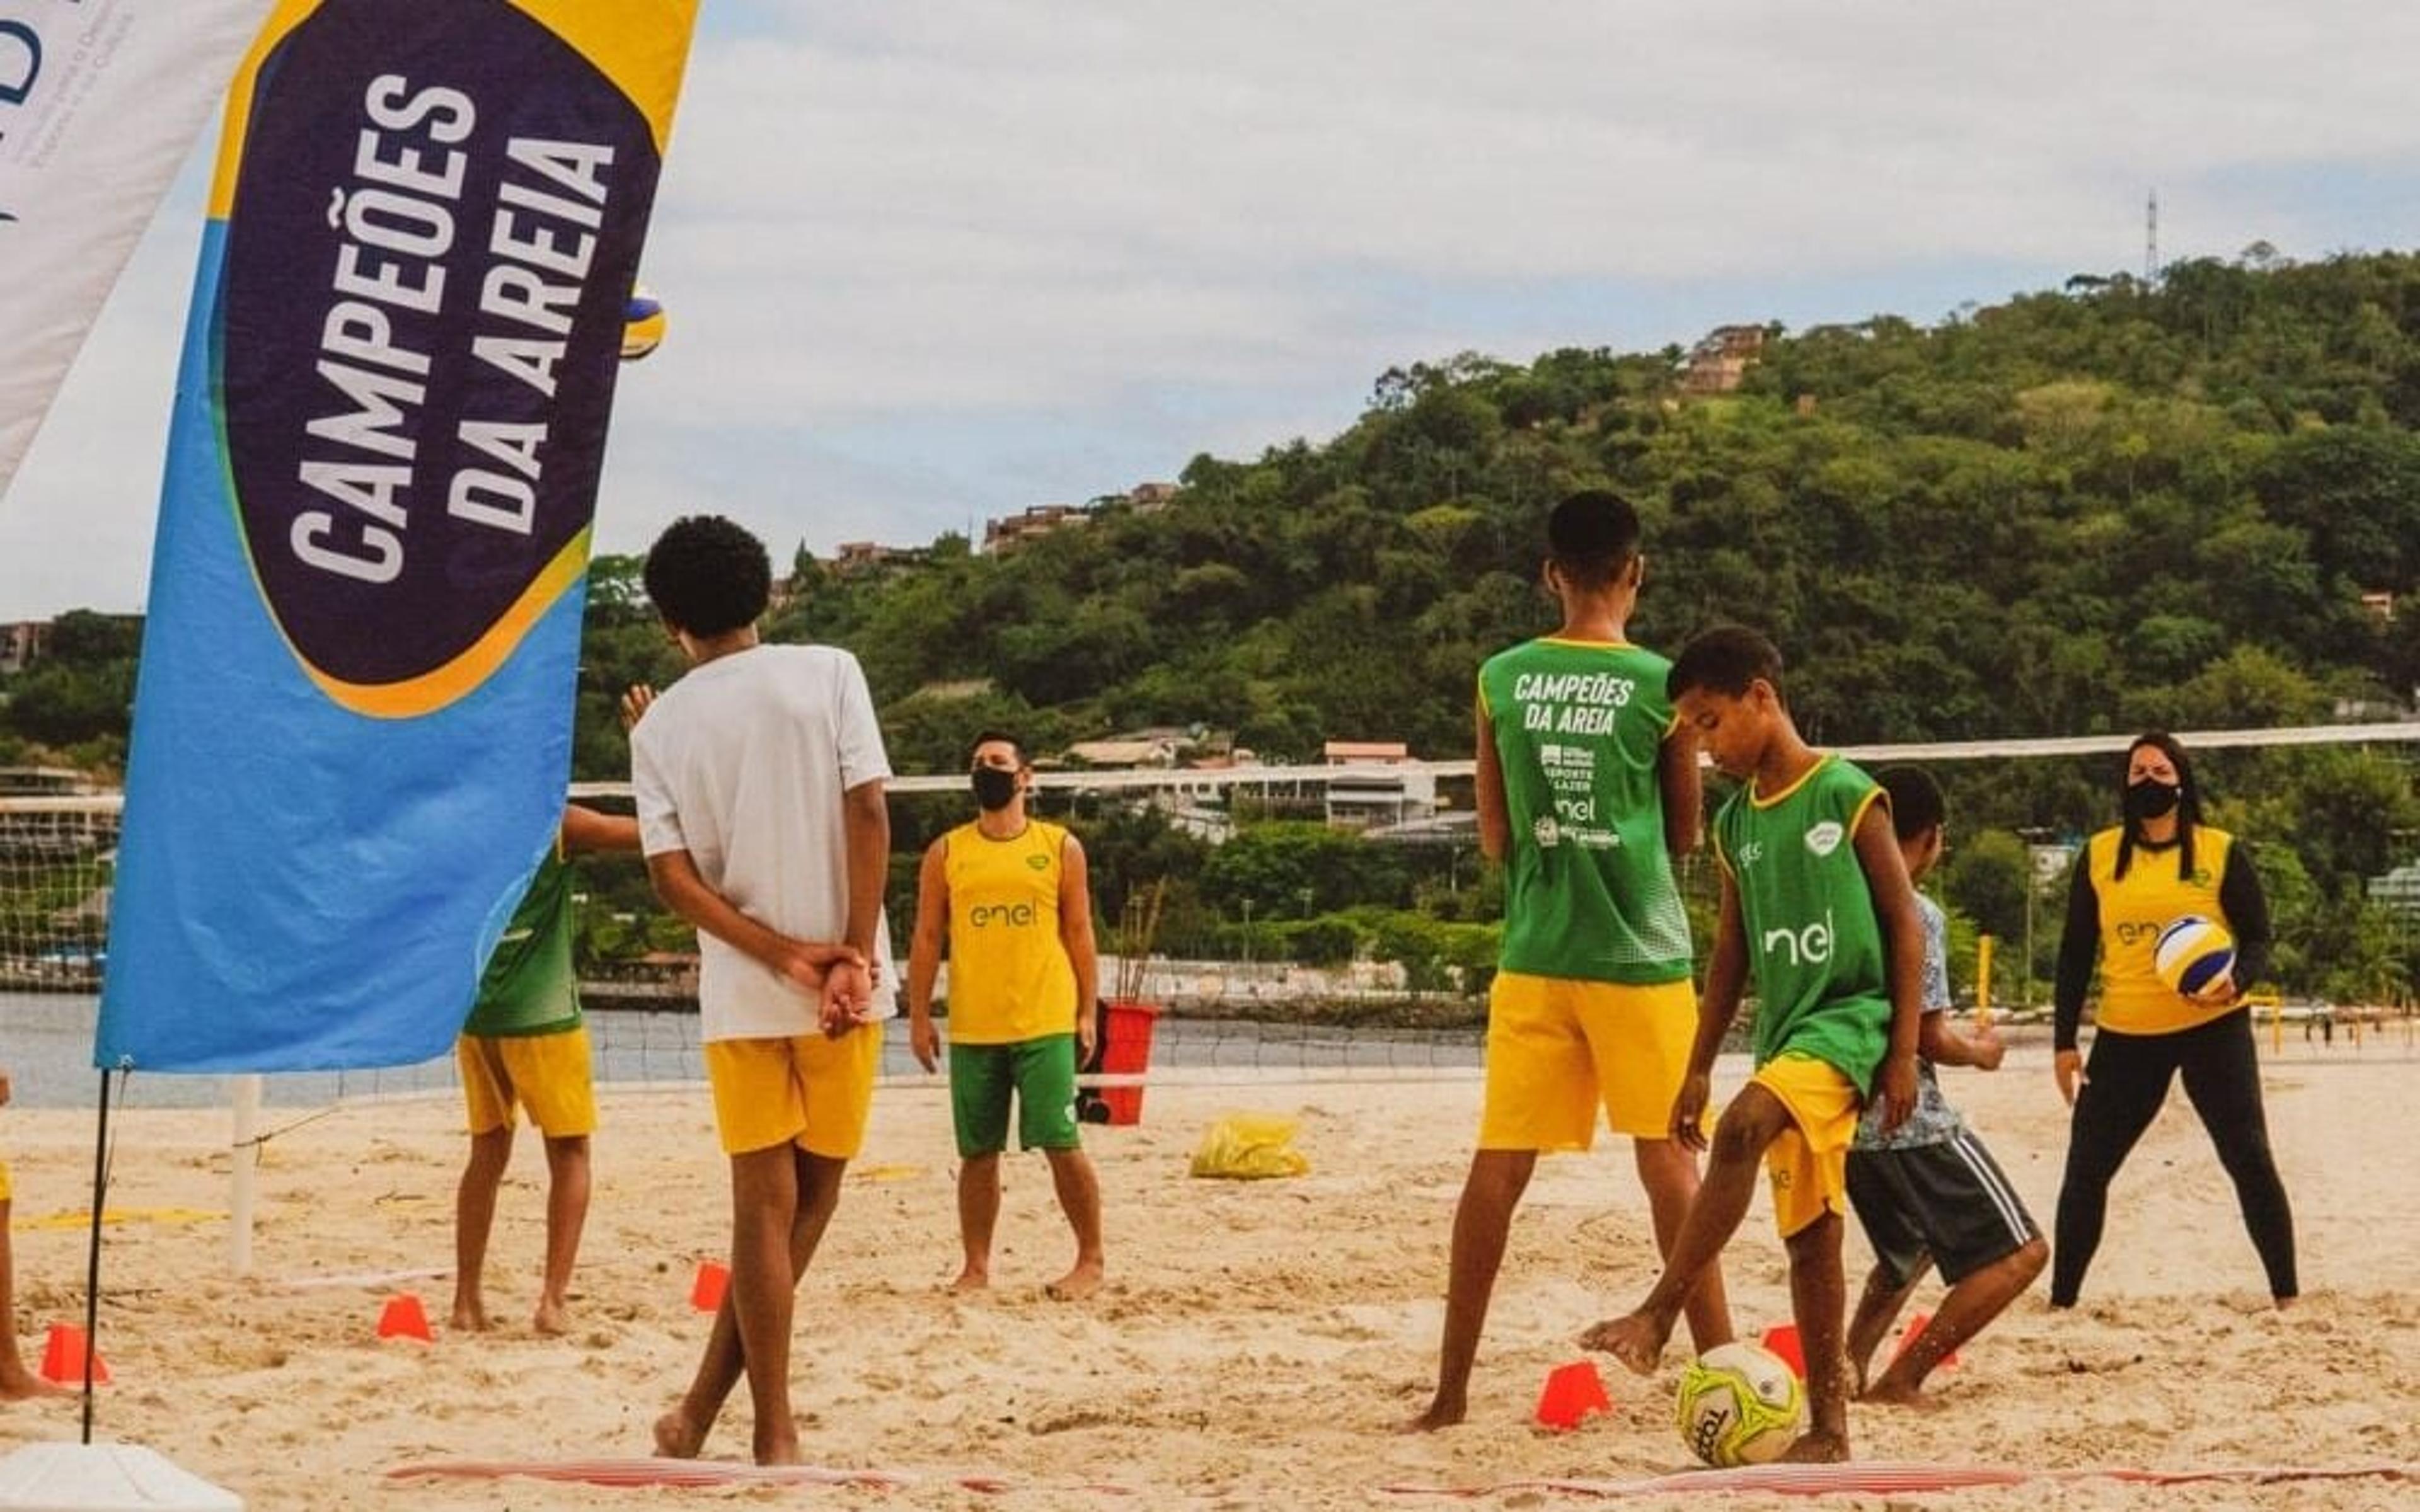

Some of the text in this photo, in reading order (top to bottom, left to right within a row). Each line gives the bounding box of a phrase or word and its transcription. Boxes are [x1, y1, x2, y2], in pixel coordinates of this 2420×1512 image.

[289, 74, 476, 584] CAMPEÕES
[447, 137, 616, 536] DA AREIA
[1514, 672, 1635, 707] CAMPEÕES
[1525, 703, 1616, 736] DA AREIA
[1554, 796, 1596, 821] nel
[970, 896, 1037, 927] enel
[1765, 907, 1835, 966] nel
[2117, 922, 2160, 946] en
